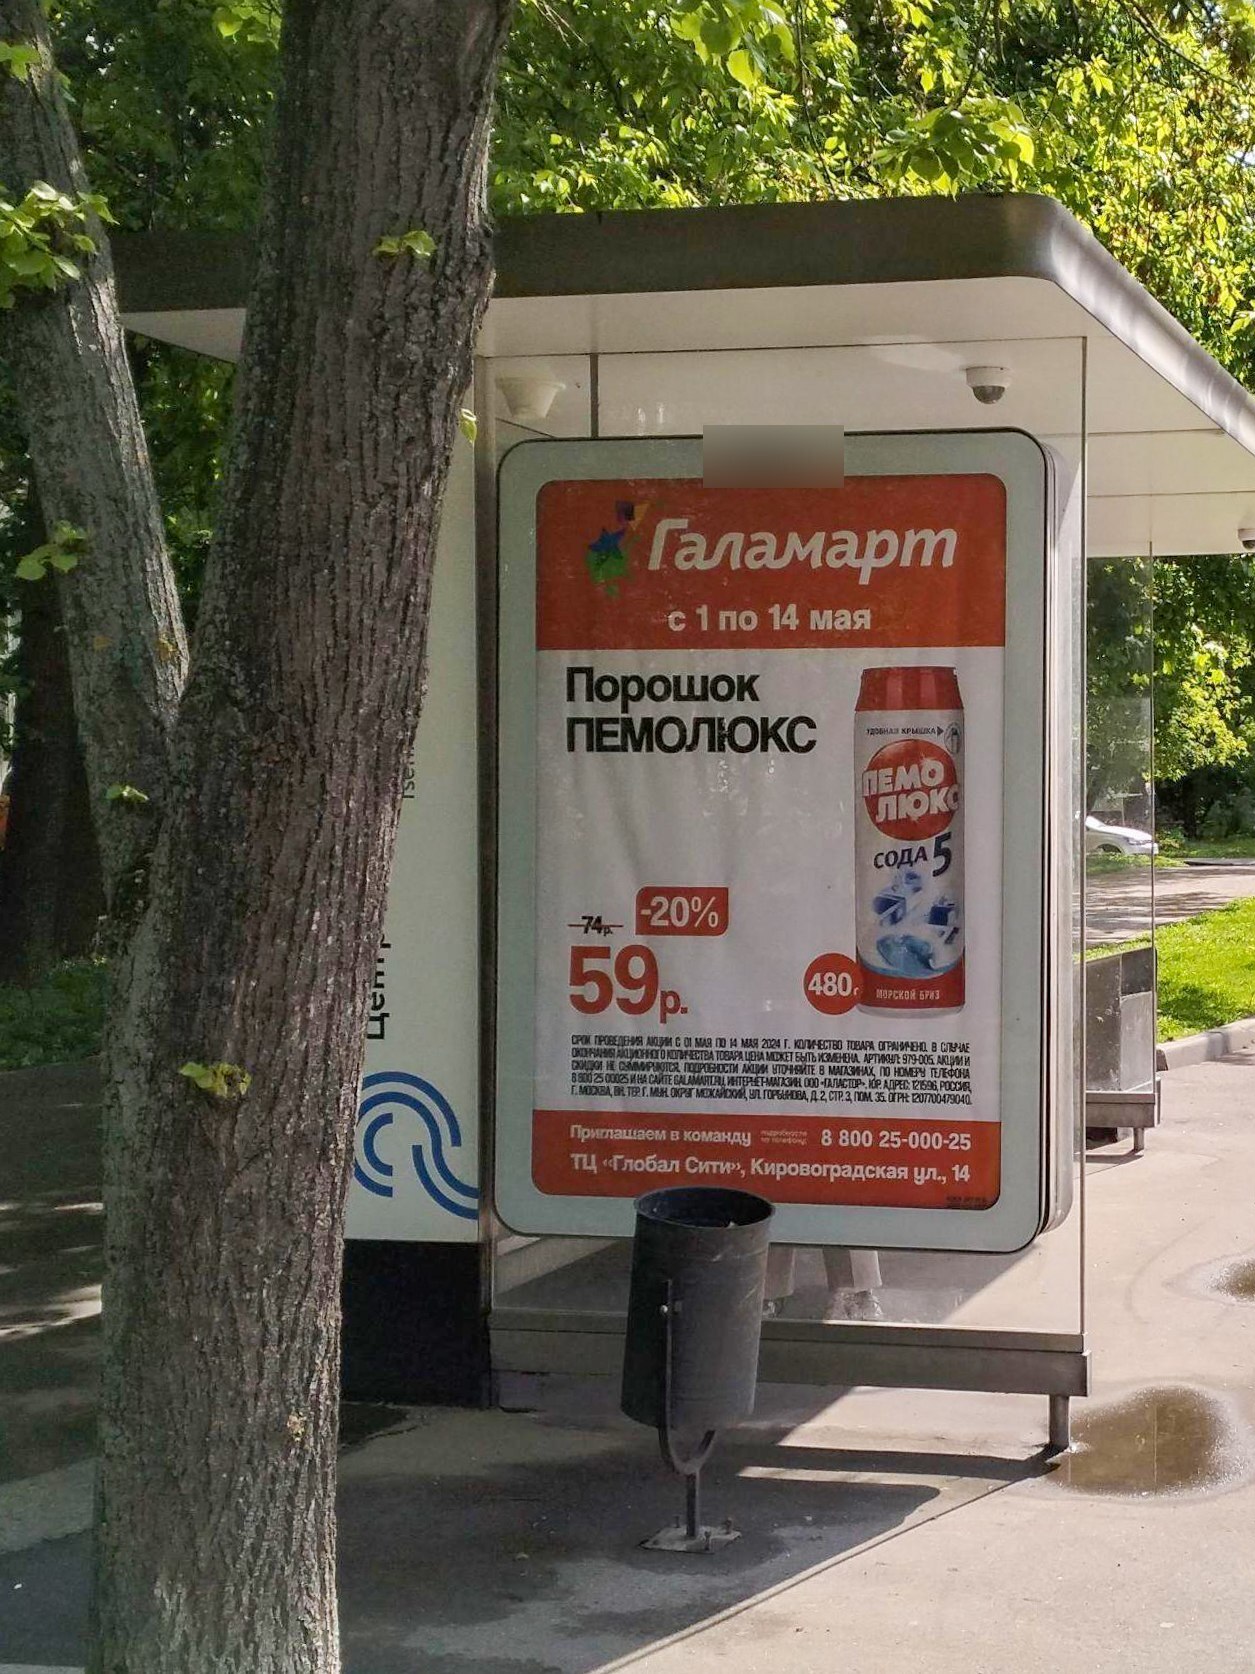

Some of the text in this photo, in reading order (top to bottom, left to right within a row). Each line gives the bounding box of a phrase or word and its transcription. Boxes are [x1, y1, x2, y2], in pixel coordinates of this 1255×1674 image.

[648, 518, 958, 585] Галамарт
[667, 604, 871, 632] с 1 по 14 мая
[566, 666, 760, 714] Порошок
[566, 716, 817, 754] ПЕМОЛЮКС
[862, 758, 945, 797] ПЕМО
[875, 784, 960, 822] ЛЮКС
[873, 831, 952, 877] СОДА 5
[640, 896, 718, 927] -20%
[876, 988, 940, 1000] МОРСКОЙ БРИЗ
[695, 1037, 712, 1048] МАЯ
[715, 1038, 727, 1048] ПО
[730, 1038, 737, 1048] 14
[741, 1038, 758, 1049] МАЯ
[761, 1038, 780, 1049] 2024
[794, 1039, 843, 1050] КОЛИЧЕСТВО
[846, 1040, 875, 1051] ТОВАРА
[931, 1042, 938, 1053] В
[941, 1042, 970, 1053] СЛУЧАЕ
[716, 1050, 743, 1061] ТОВАРА
[745, 1051, 764, 1063] ЦЕНА
[766, 1051, 793, 1062] МОЖЕТ
[795, 1052, 817, 1062] БЫТЬ
[936, 1055, 963, 1067] АКЦИИ
[964, 1056, 971, 1067] И
[648, 1073, 673, 1085] САЙТЕ
[804, 1077, 819, 1088] ООО
[684, 1062, 738, 1074] ПОДРОБНОСТИ
[741, 1063, 768, 1076] АКЦИИ
[772, 1063, 815, 1075] УТОЧНЯЙТЕ
[819, 1065, 825, 1075] В
[828, 1066, 876, 1078] МАГАЗИНАХ,
[879, 1067, 890, 1077] ПО
[894, 1067, 926, 1078] НОМЕРУ
[930, 1068, 971, 1079] ТЕЛЕФОНА
[570, 1125, 752, 1147] Приглашаем в команду
[820, 1129, 971, 1150] 8 800 25-000-25
[570, 1153, 970, 1185] ТЦ «Глобал Сити», Кировоградская ул., 14
